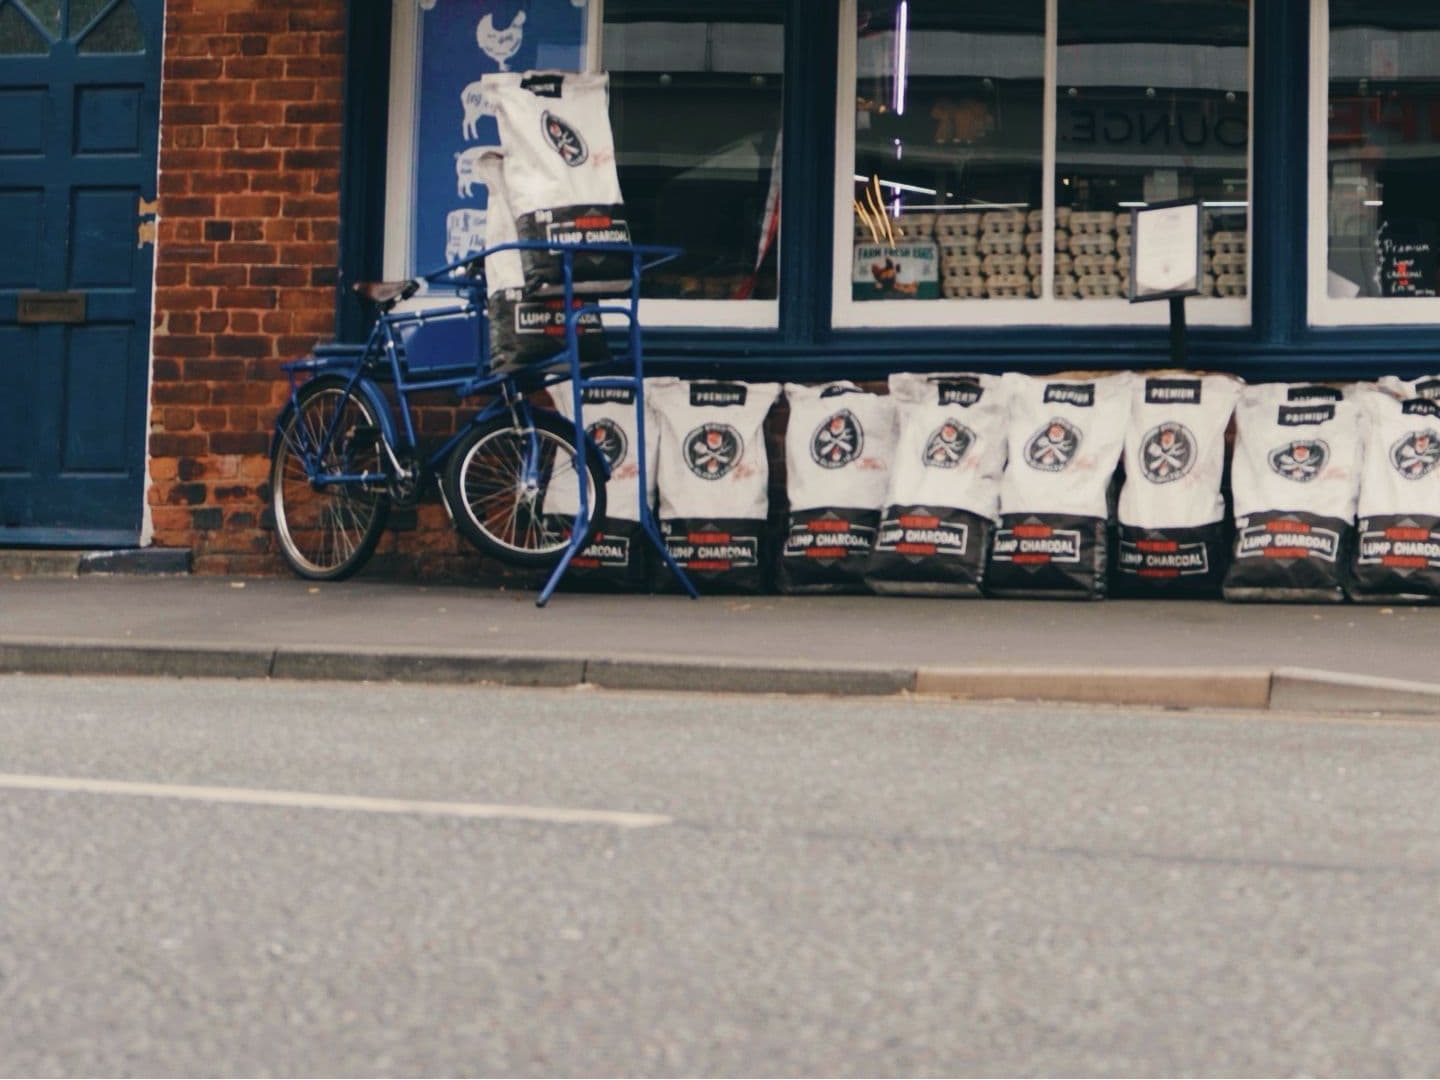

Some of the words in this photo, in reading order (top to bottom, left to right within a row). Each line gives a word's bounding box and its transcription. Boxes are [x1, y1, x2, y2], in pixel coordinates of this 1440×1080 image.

[521, 312, 551, 325] LUMP
[1151, 387, 1194, 399] PREMIUM
[816, 534, 870, 547] CHARCOAL
[906, 530, 961, 545] CHARCOAL
[1244, 535, 1272, 549] LUMP
[1274, 534, 1332, 552] CHARCOAL
[698, 546, 752, 559] CHARCOAL
[1020, 540, 1074, 552] CHARCOAL
[1364, 542, 1391, 555] LUMP
[1146, 553, 1202, 566] CHARCOAL
